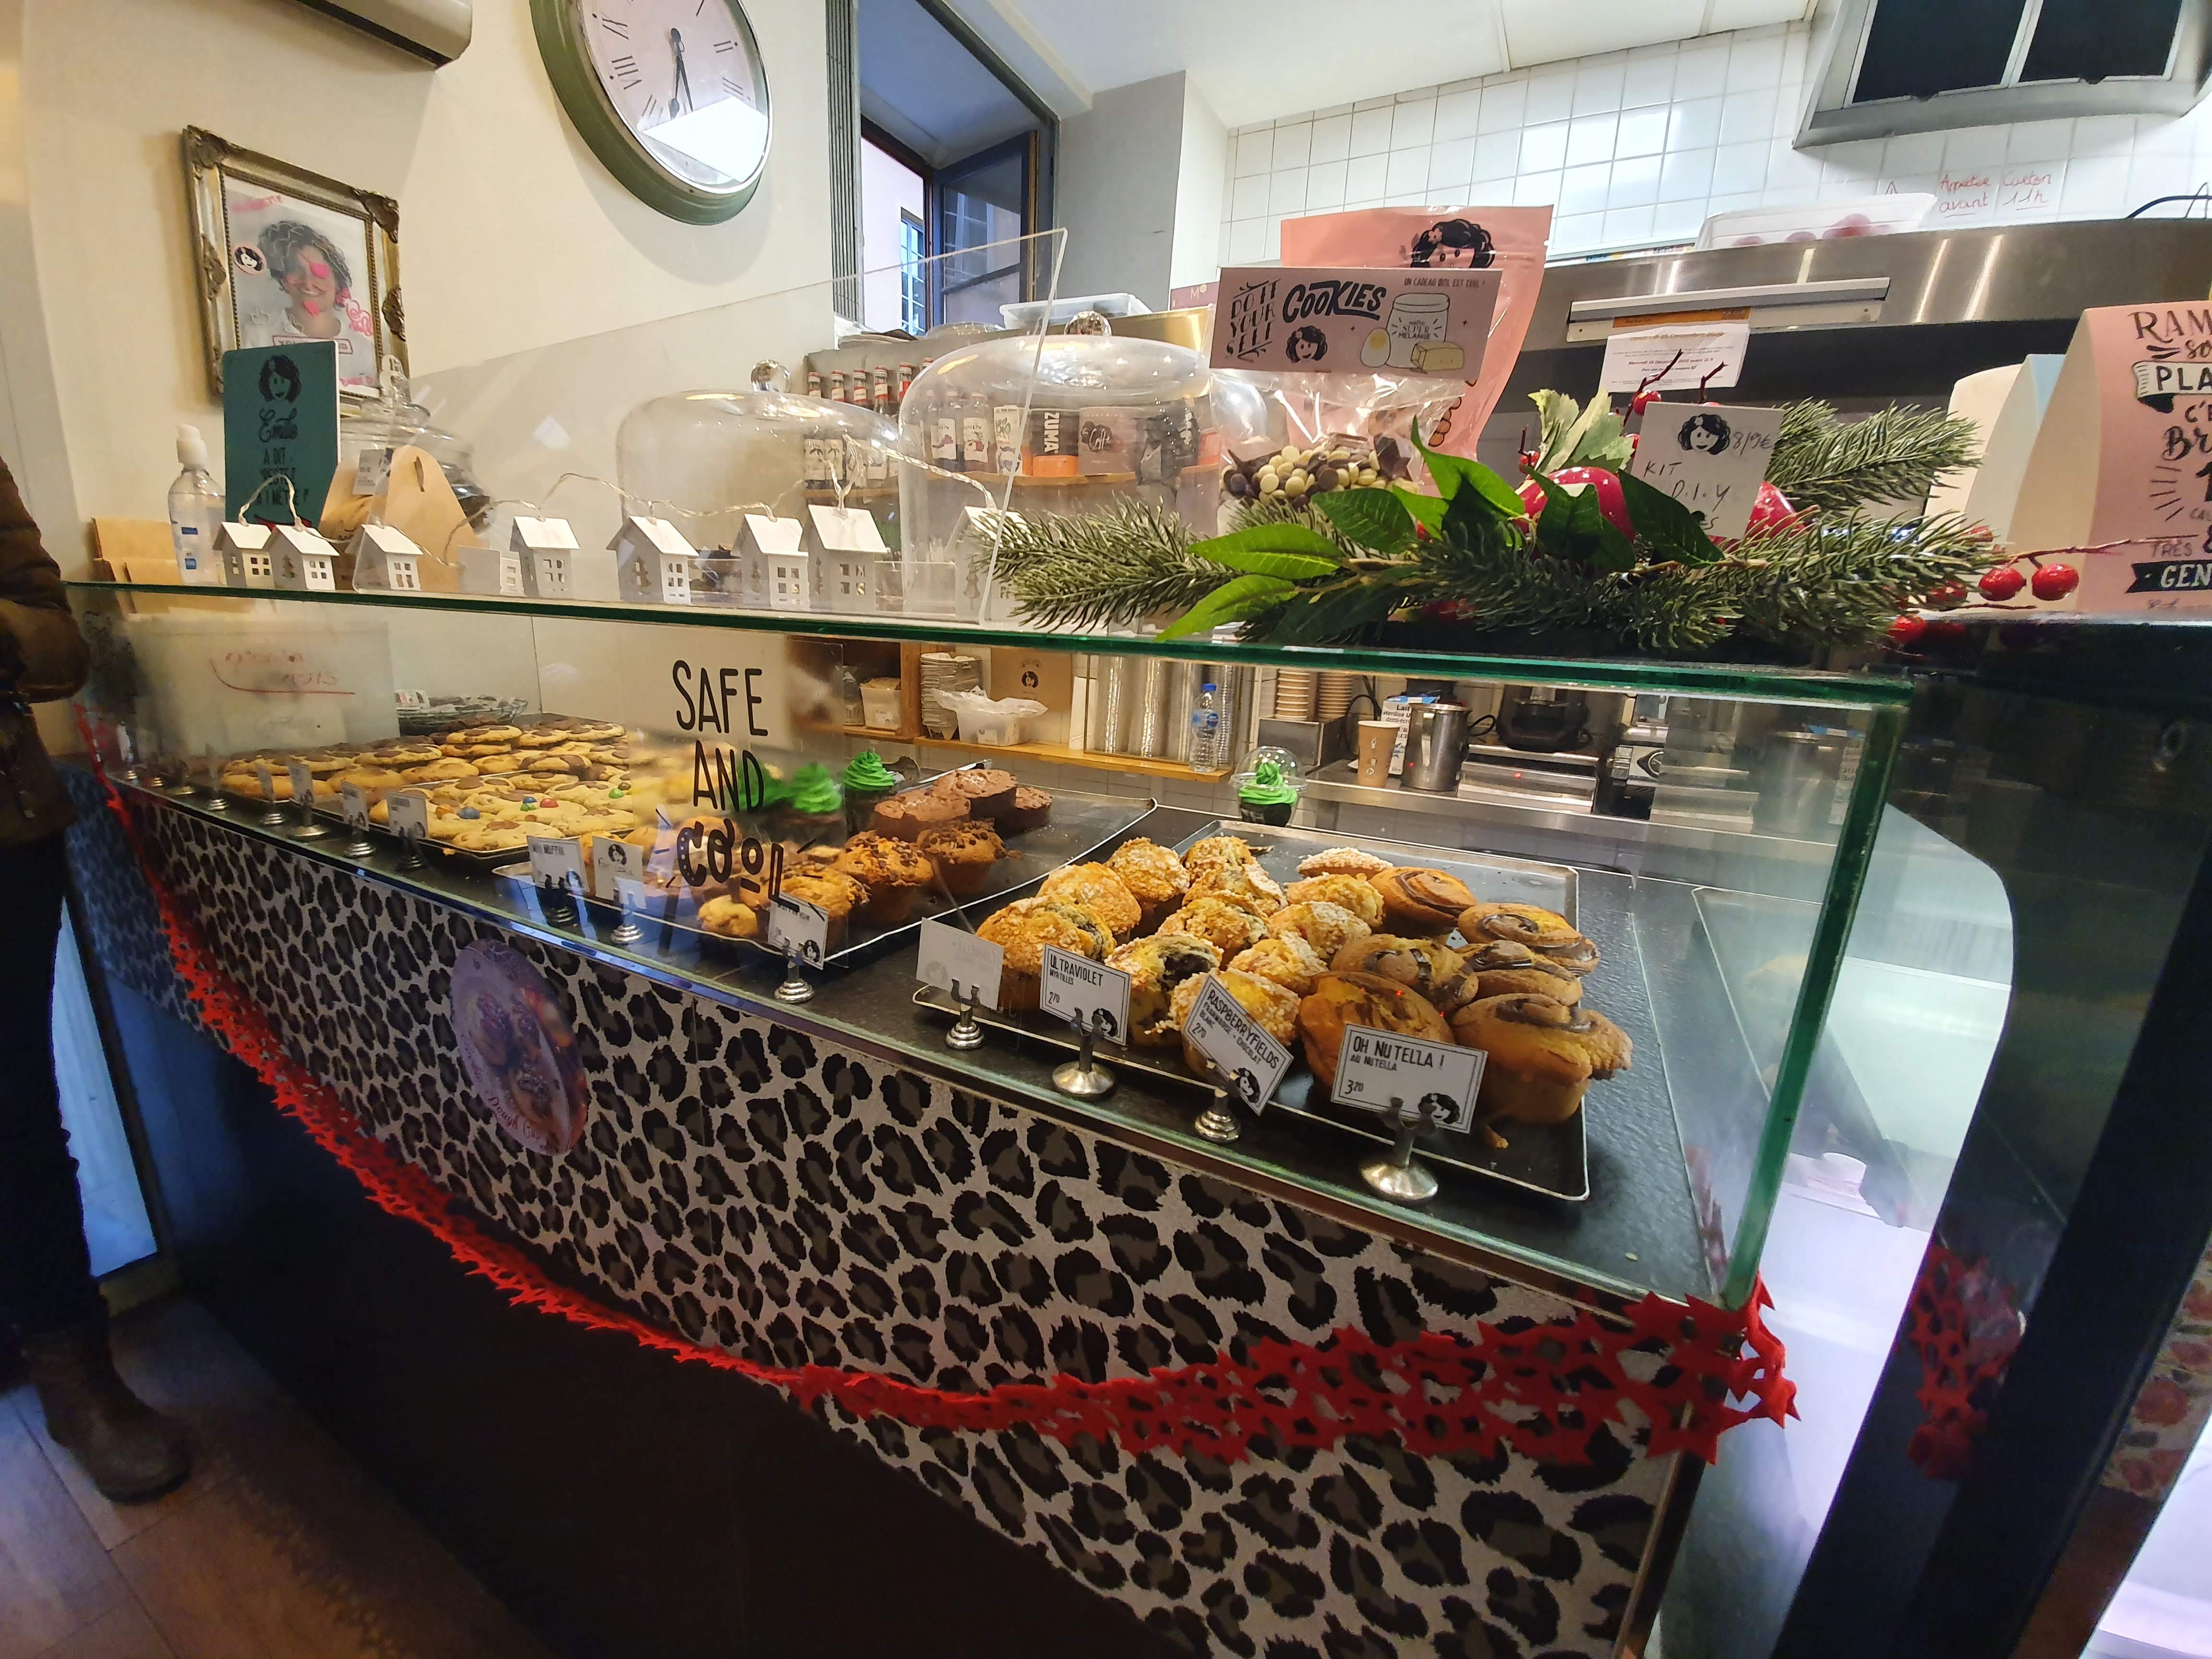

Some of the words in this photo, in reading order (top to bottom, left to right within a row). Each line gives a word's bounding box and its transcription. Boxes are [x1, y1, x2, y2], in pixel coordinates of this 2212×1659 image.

[1940, 192, 1989, 213] avant
[1231, 293, 1254, 319] DO
[1260, 279, 1281, 304] IT
[1404, 277, 1412, 286] UN
[1413, 277, 1436, 287] CADEAU
[1452, 279, 1464, 287] EST
[1466, 279, 1479, 288] COOL
[1230, 301, 1276, 338] YOUR
[1282, 280, 1387, 324] COOKIES
[1225, 320, 1274, 359] SELF
[1044, 412, 1059, 454] ZUMA
[1643, 460, 1682, 478] KIT
[673, 660, 768, 736] SAFE
[693, 740, 764, 813] AND
[1050, 954, 1103, 986] ULTRAVIOLET
[1050, 969, 1074, 985] MYRTILLES
[1207, 989, 1279, 1069] RASPBERRYFIELDS
[1350, 1054, 1360, 1063] AU
[1364, 1058, 1397, 1071] NUTELLA
[1353, 1036, 1369, 1054] OH
[1374, 1040, 1433, 1068] NUTELLA
